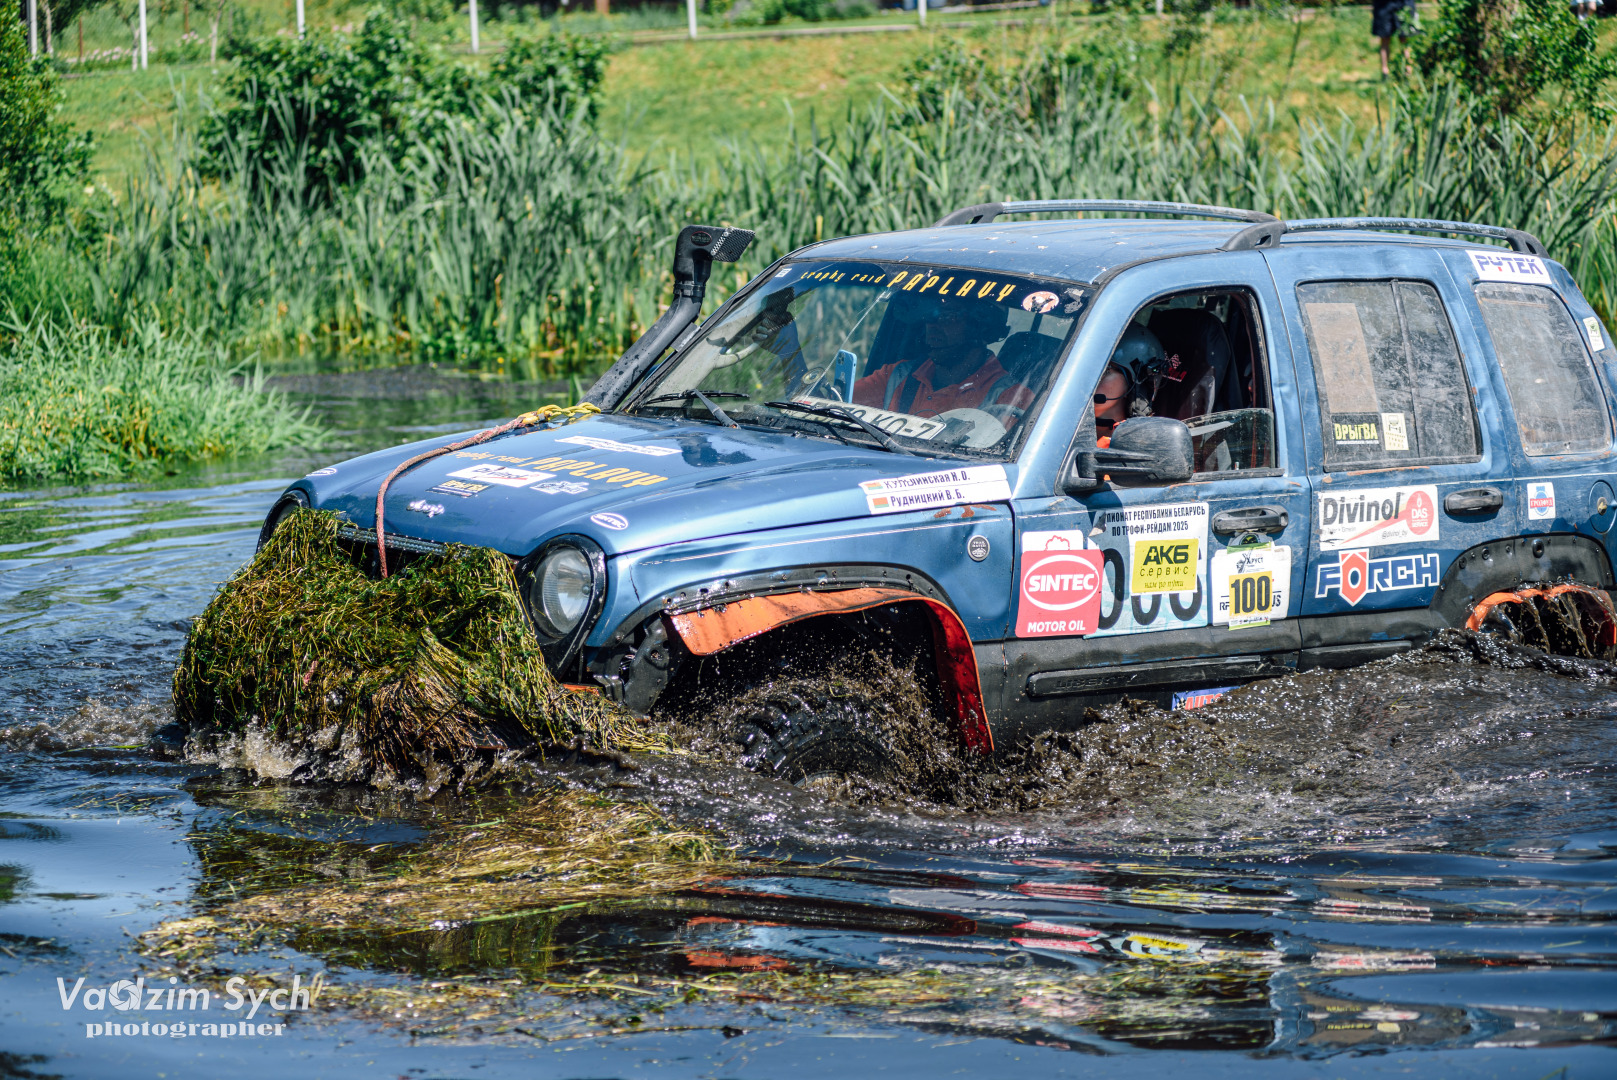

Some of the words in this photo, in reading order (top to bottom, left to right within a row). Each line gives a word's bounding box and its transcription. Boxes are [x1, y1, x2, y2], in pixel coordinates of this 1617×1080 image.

[851, 273, 886, 284] raid
[887, 270, 1017, 302] PAPLAVY
[890, 489, 945, 507] Рудницкий
[945, 489, 956, 500] В.
[955, 488, 965, 499] Б.
[1105, 511, 1132, 522] ПИОНАТ
[1133, 508, 1173, 521] РЕСПУБЛИКИ
[1174, 505, 1206, 518] БЕЛАРУСЬ
[1322, 491, 1401, 526] Divinol
[1411, 508, 1428, 519] DAS
[1112, 526, 1121, 536] ПО
[1121, 522, 1172, 535] ТРОФИ-РЕЙДАМ
[1173, 521, 1189, 531] 2025
[1143, 545, 1189, 565] АКБ
[1028, 573, 1095, 592] SINTEC
[1231, 576, 1270, 615] 100
[1027, 621, 1067, 633] MOTOR
[1068, 620, 1086, 631] OIL
